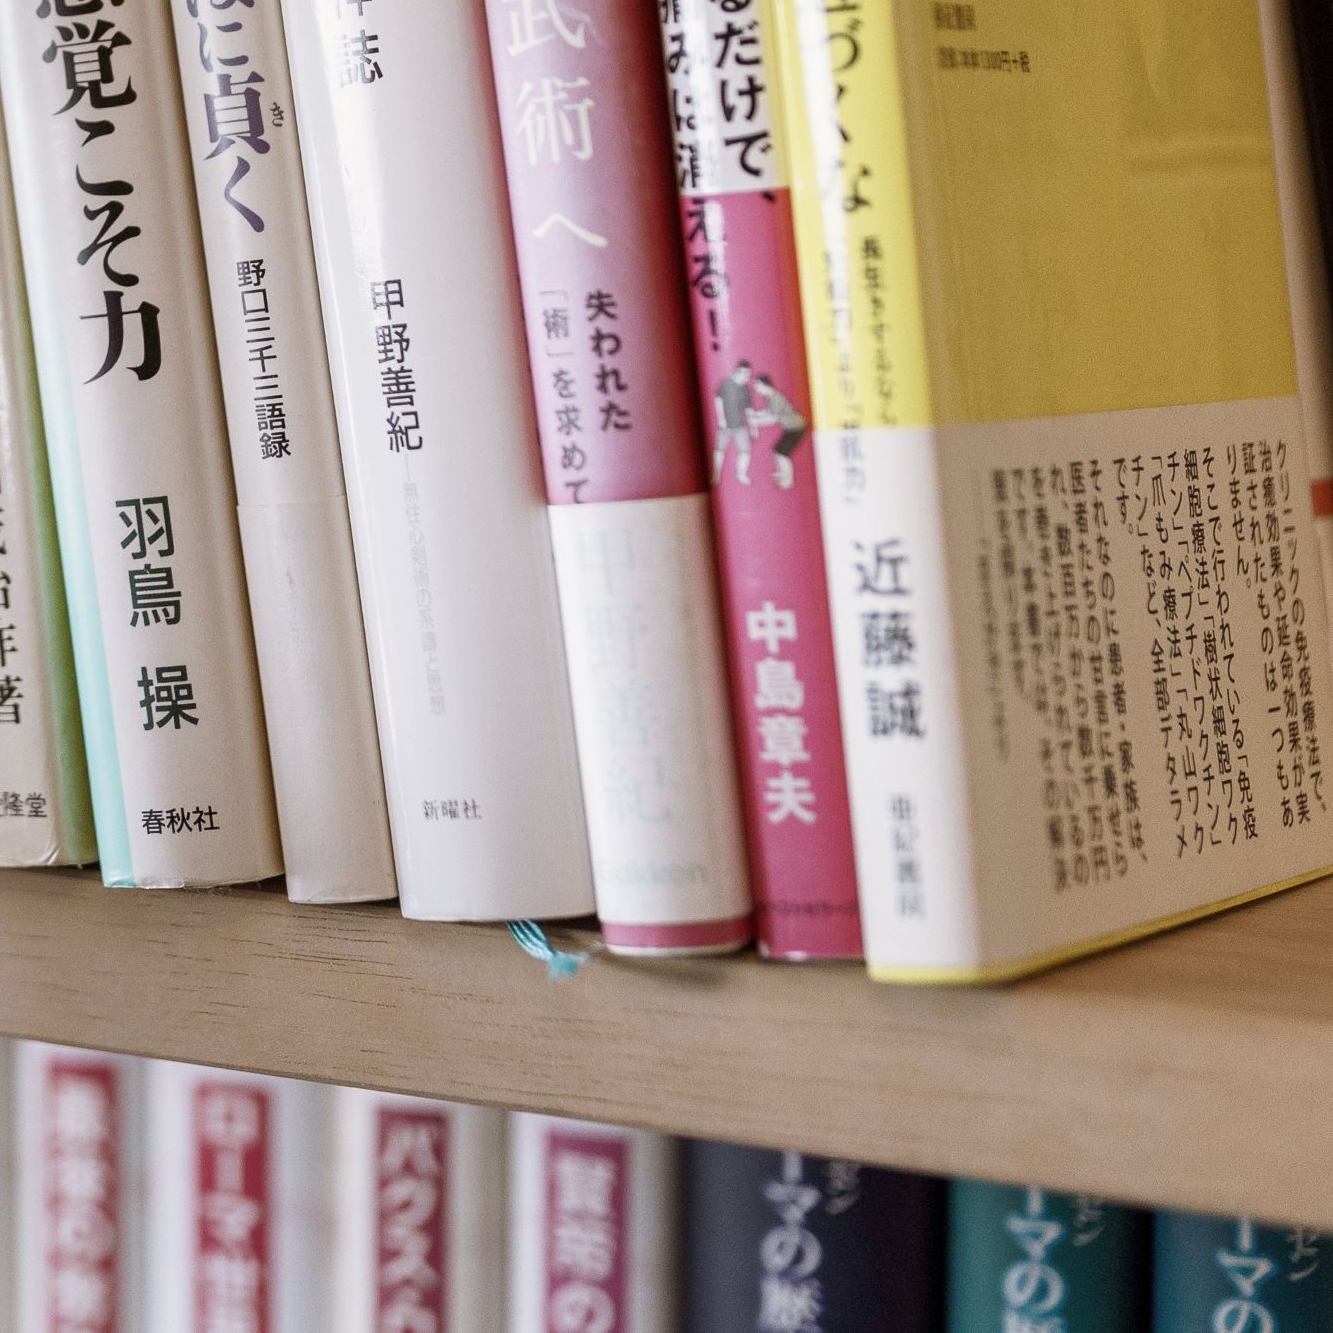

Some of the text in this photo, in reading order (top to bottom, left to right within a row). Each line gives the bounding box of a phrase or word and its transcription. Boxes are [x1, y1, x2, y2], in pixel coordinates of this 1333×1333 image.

[236, 258, 292, 461] 野口三千三語録
[369, 277, 425, 455] 甲野善紀
[538, 287, 591, 506] 「術」を求めて
[585, 288, 633, 434] 失われた
[114, 494, 184, 629] 羽鳥
[1113, 457, 1134, 535] です。
[1226, 444, 1252, 589] りません。
[745, 600, 818, 826] 中島章夫
[851, 537, 927, 739] 近藤誠
[1131, 455, 1188, 860] チン」など、全部デタラメ
[1151, 455, 1204, 855] 「爪もみ療法」「丸山ワク
[1167, 451, 1222, 846] チン」「ペプチドワクチン」
[1184, 448, 1238, 845] 細胞療法」「樹状細胞ワク
[1202, 447, 1259, 840] そこで行われている「免疫
[1242, 442, 1294, 828] 証されたものは一つもあ
[1259, 440, 1311, 825] 治癒効果や延命効果が実
[1277, 440, 1327, 812] クリニックの免疫療法で、
[141, 805, 222, 836] 春秋社
[421, 797, 484, 822] 新曜社
